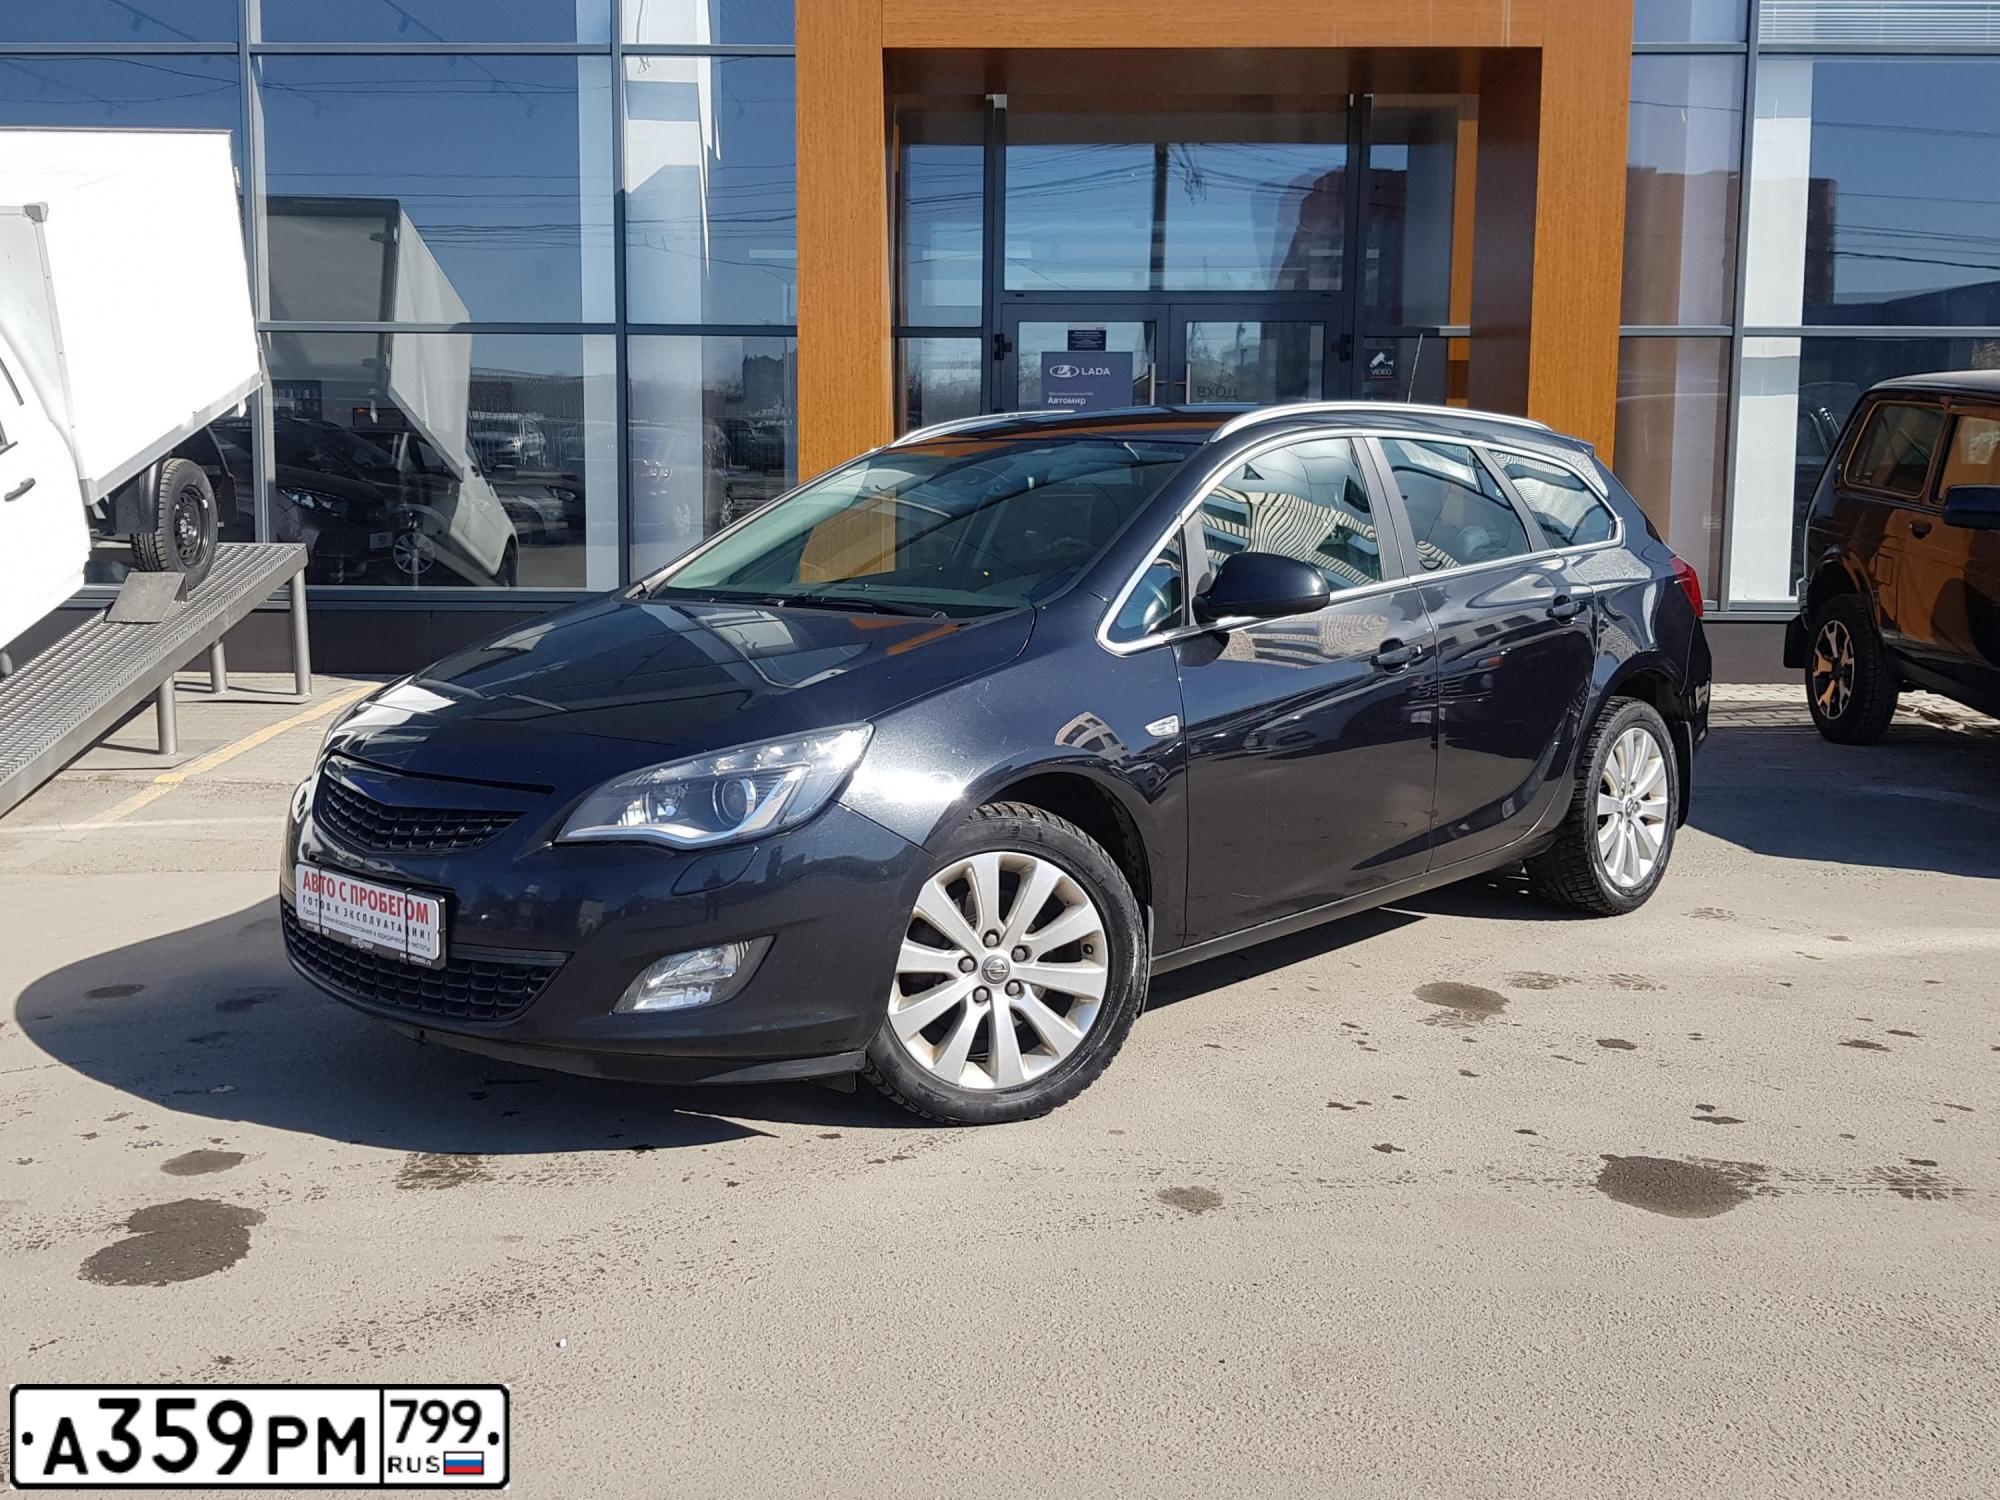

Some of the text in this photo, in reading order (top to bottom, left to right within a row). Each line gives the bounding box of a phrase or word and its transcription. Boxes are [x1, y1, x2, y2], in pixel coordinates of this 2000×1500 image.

[1081, 367, 1111, 376] LADA
[1370, 368, 1393, 376] VIDEO
[1047, 396, 1087, 406] Автомир
[302, 870, 336, 898] АВТО
[339, 881, 347, 902] С
[350, 883, 429, 926] ПРОБЕГОМ
[302, 894, 331, 912] ГОТОВ
[343, 907, 431, 942] ЭКСПЛУАТАИИ!
